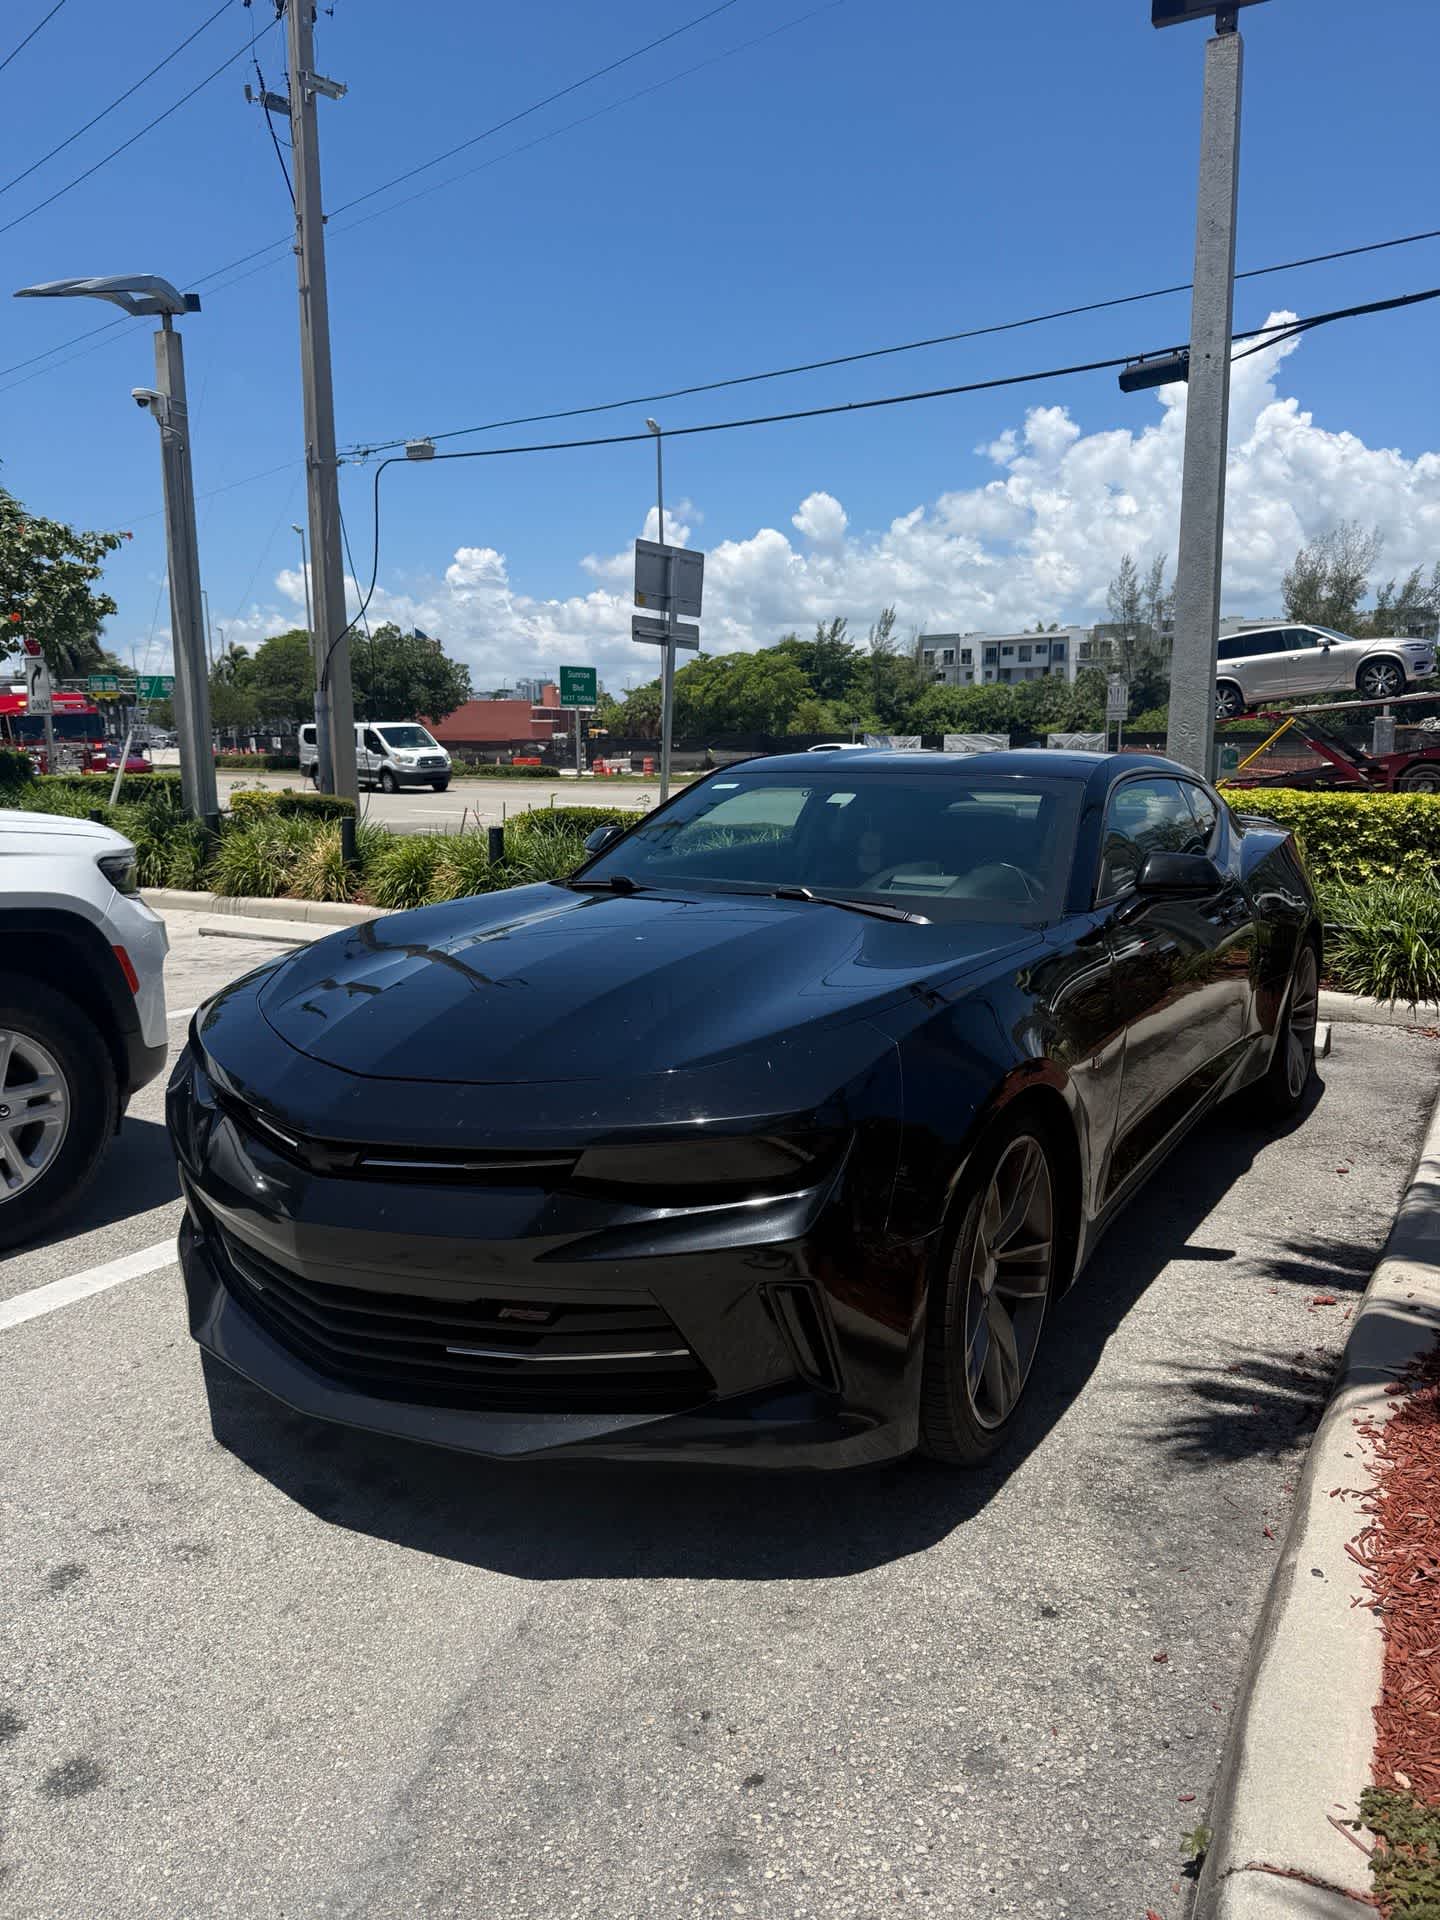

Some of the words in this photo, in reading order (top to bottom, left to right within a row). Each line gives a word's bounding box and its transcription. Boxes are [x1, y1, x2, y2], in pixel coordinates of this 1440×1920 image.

[567, 670, 590, 679] Sunrise
[572, 683, 584, 692] Blvd
[31, 699, 49, 711] ONLY
[497, 1308, 551, 1321] RS
